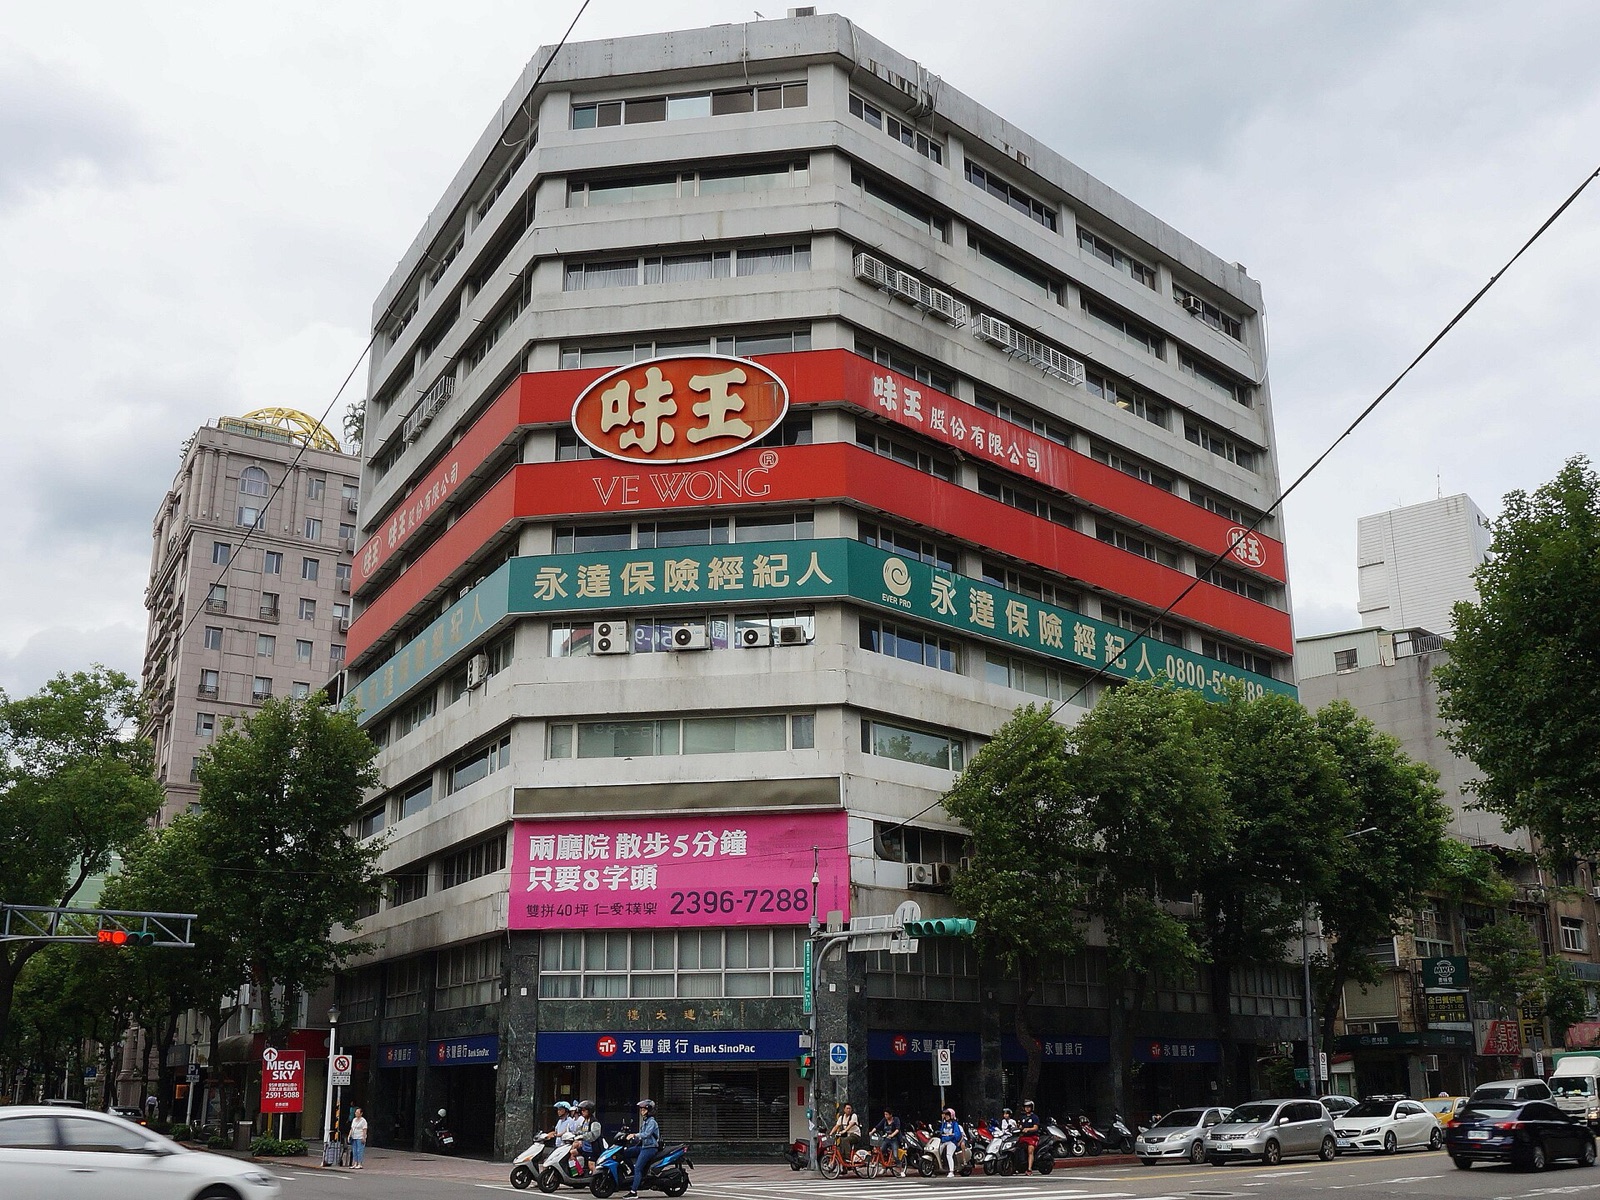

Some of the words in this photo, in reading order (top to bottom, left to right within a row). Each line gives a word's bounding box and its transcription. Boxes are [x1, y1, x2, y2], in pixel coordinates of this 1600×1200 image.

[600, 366, 753, 453] 味王
[592, 475, 640, 506] VE
[649, 467, 771, 503] WONG
[363, 540, 379, 574] 味王
[1231, 530, 1261, 565] 味王
[533, 551, 833, 601] 永達保險經紀人
[882, 592, 898, 606] EVER
[899, 597, 912, 609] PRO
[930, 575, 1156, 678] 永達保險經紀人
[529, 833, 611, 861] 兩廳院
[615, 829, 748, 860] 散步5分鐘
[526, 863, 659, 893] 只要8字頭
[526, 903, 590, 918] 雙拼40坪
[670, 888, 809, 915] 2396-7288
[98, 931, 112, 943] 54
[622, 1039, 689, 1054] 永豐銀行
[693, 1044, 717, 1054] Bank
[718, 1044, 756, 1054] SinoPac
[911, 1038, 956, 1053] 永豐銀行
[1045, 1042, 1083, 1056] 永豐銀行
[1163, 1044, 1196, 1057] 永豐銀行
[266, 1060, 301, 1071] MEGA
[272, 1070, 295, 1080] SKY
[265, 1091, 300, 1099] 2591-5088
